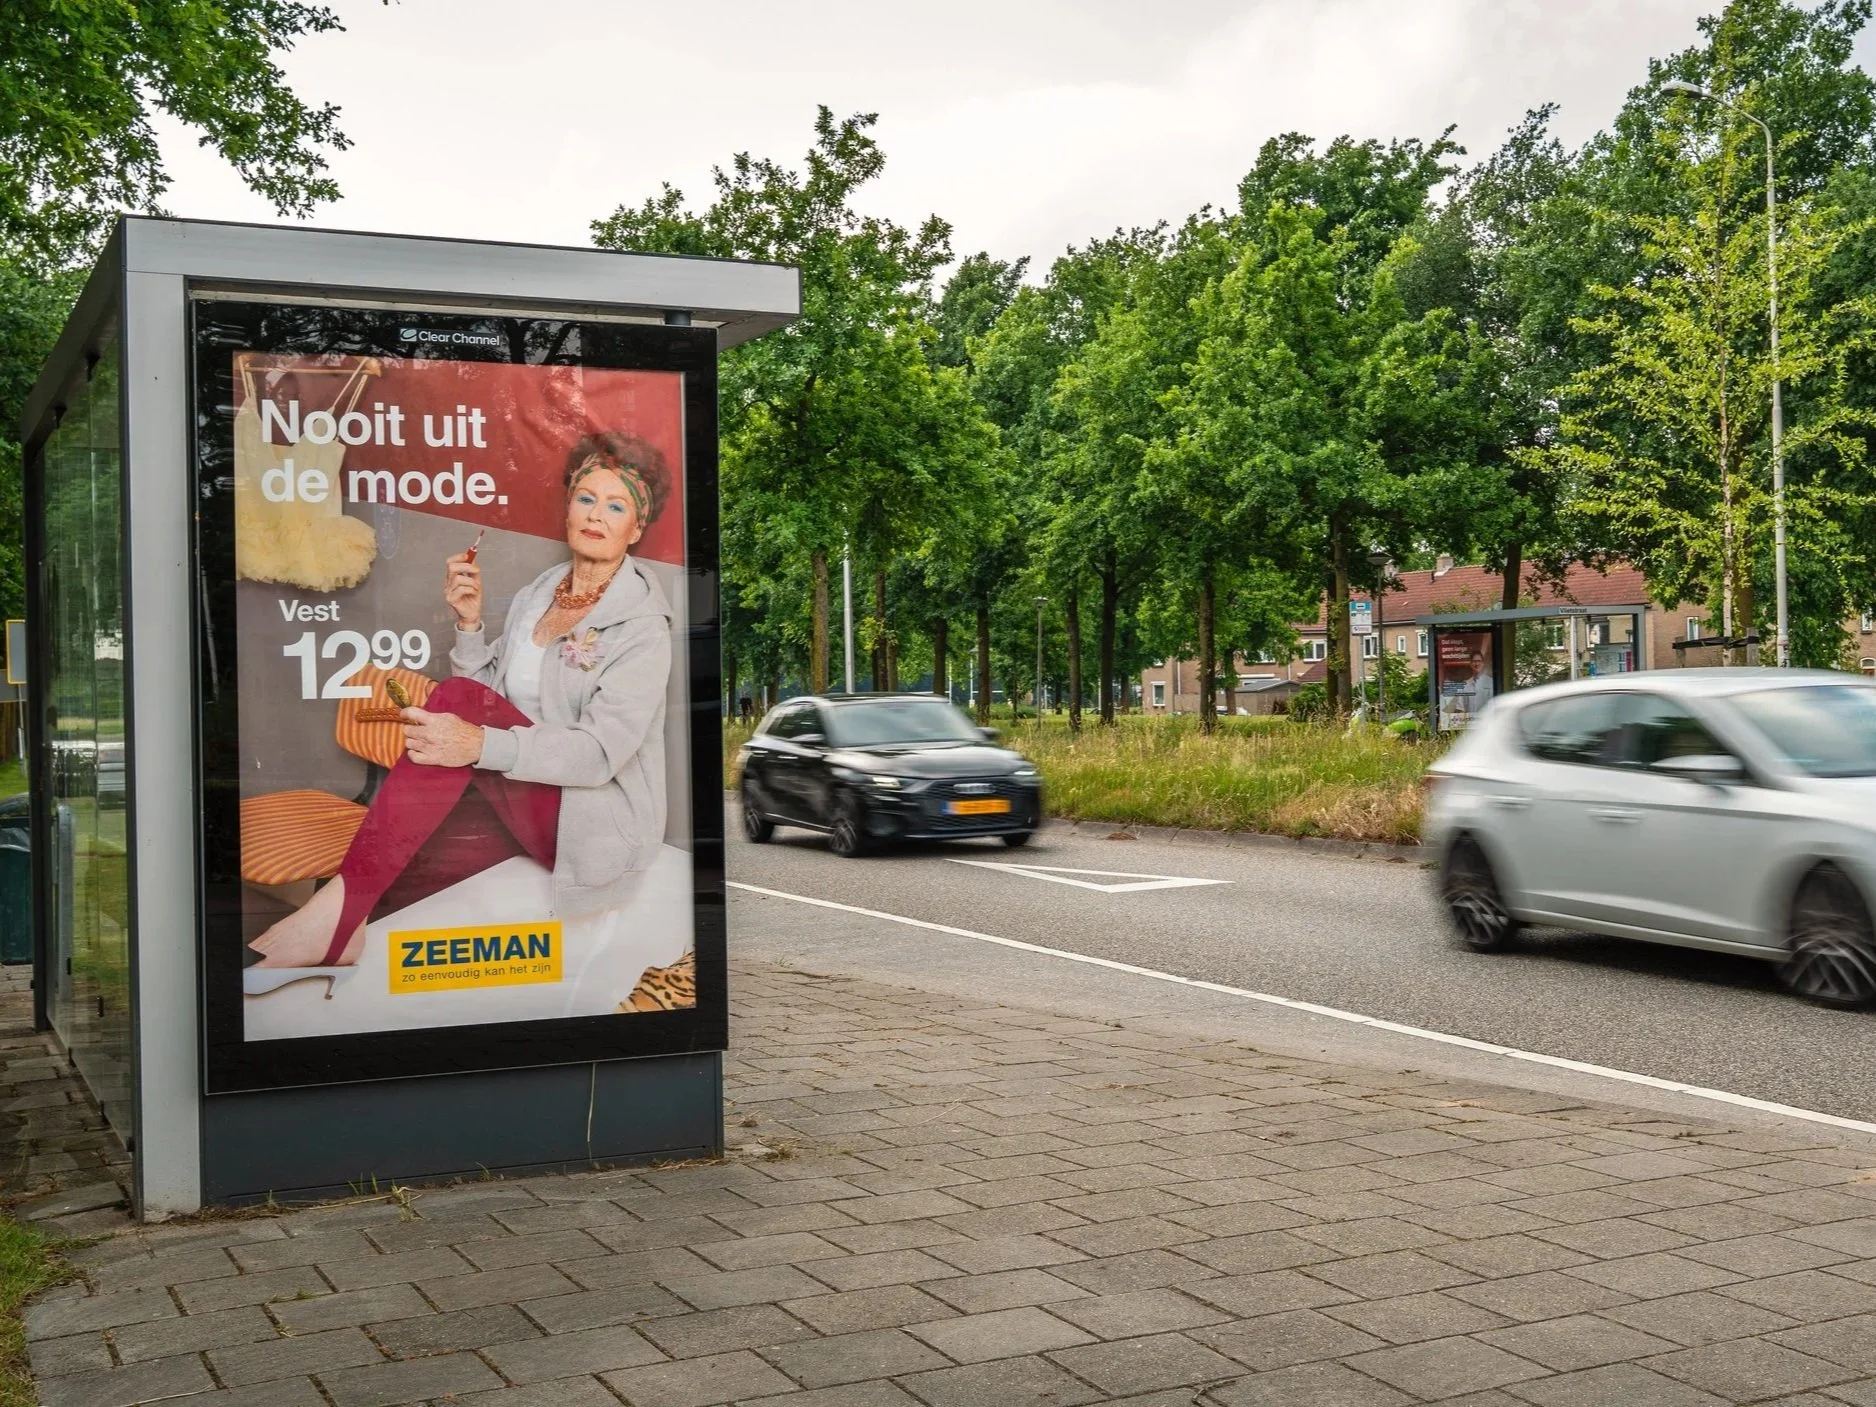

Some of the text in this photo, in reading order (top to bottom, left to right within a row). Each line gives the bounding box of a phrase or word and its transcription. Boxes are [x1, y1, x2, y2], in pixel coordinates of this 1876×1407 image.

[418, 331, 500, 345] Clear Channel
[261, 400, 487, 448] Nooit uit
[261, 459, 509, 505] de mode.
[278, 600, 340, 622] Vest
[401, 933, 551, 968] ZEEMAN
[402, 964, 551, 983] zo eenvoudig kan het zijn
